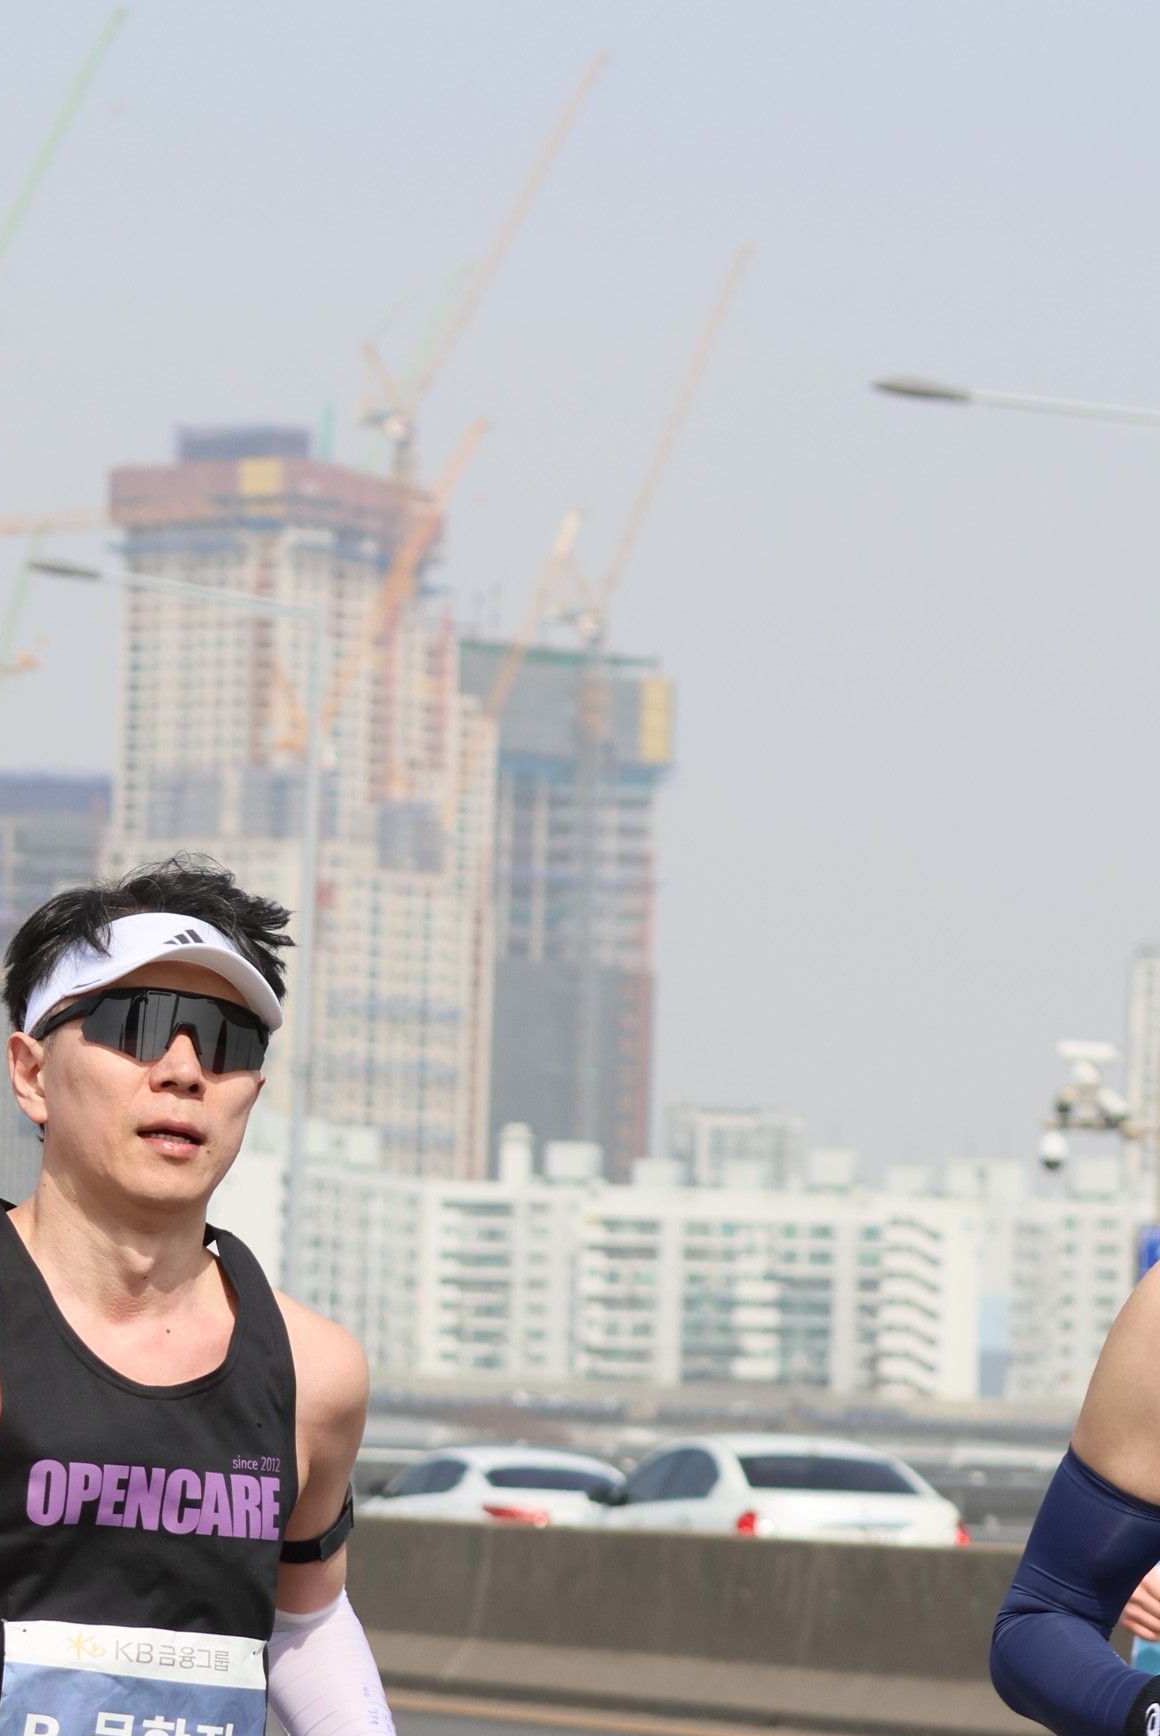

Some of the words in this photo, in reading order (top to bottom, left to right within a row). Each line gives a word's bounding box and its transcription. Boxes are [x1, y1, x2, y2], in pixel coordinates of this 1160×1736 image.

[232, 1454, 258, 1471] since
[260, 1456, 281, 1473] 2012
[26, 1459, 281, 1541] OPENCARE
